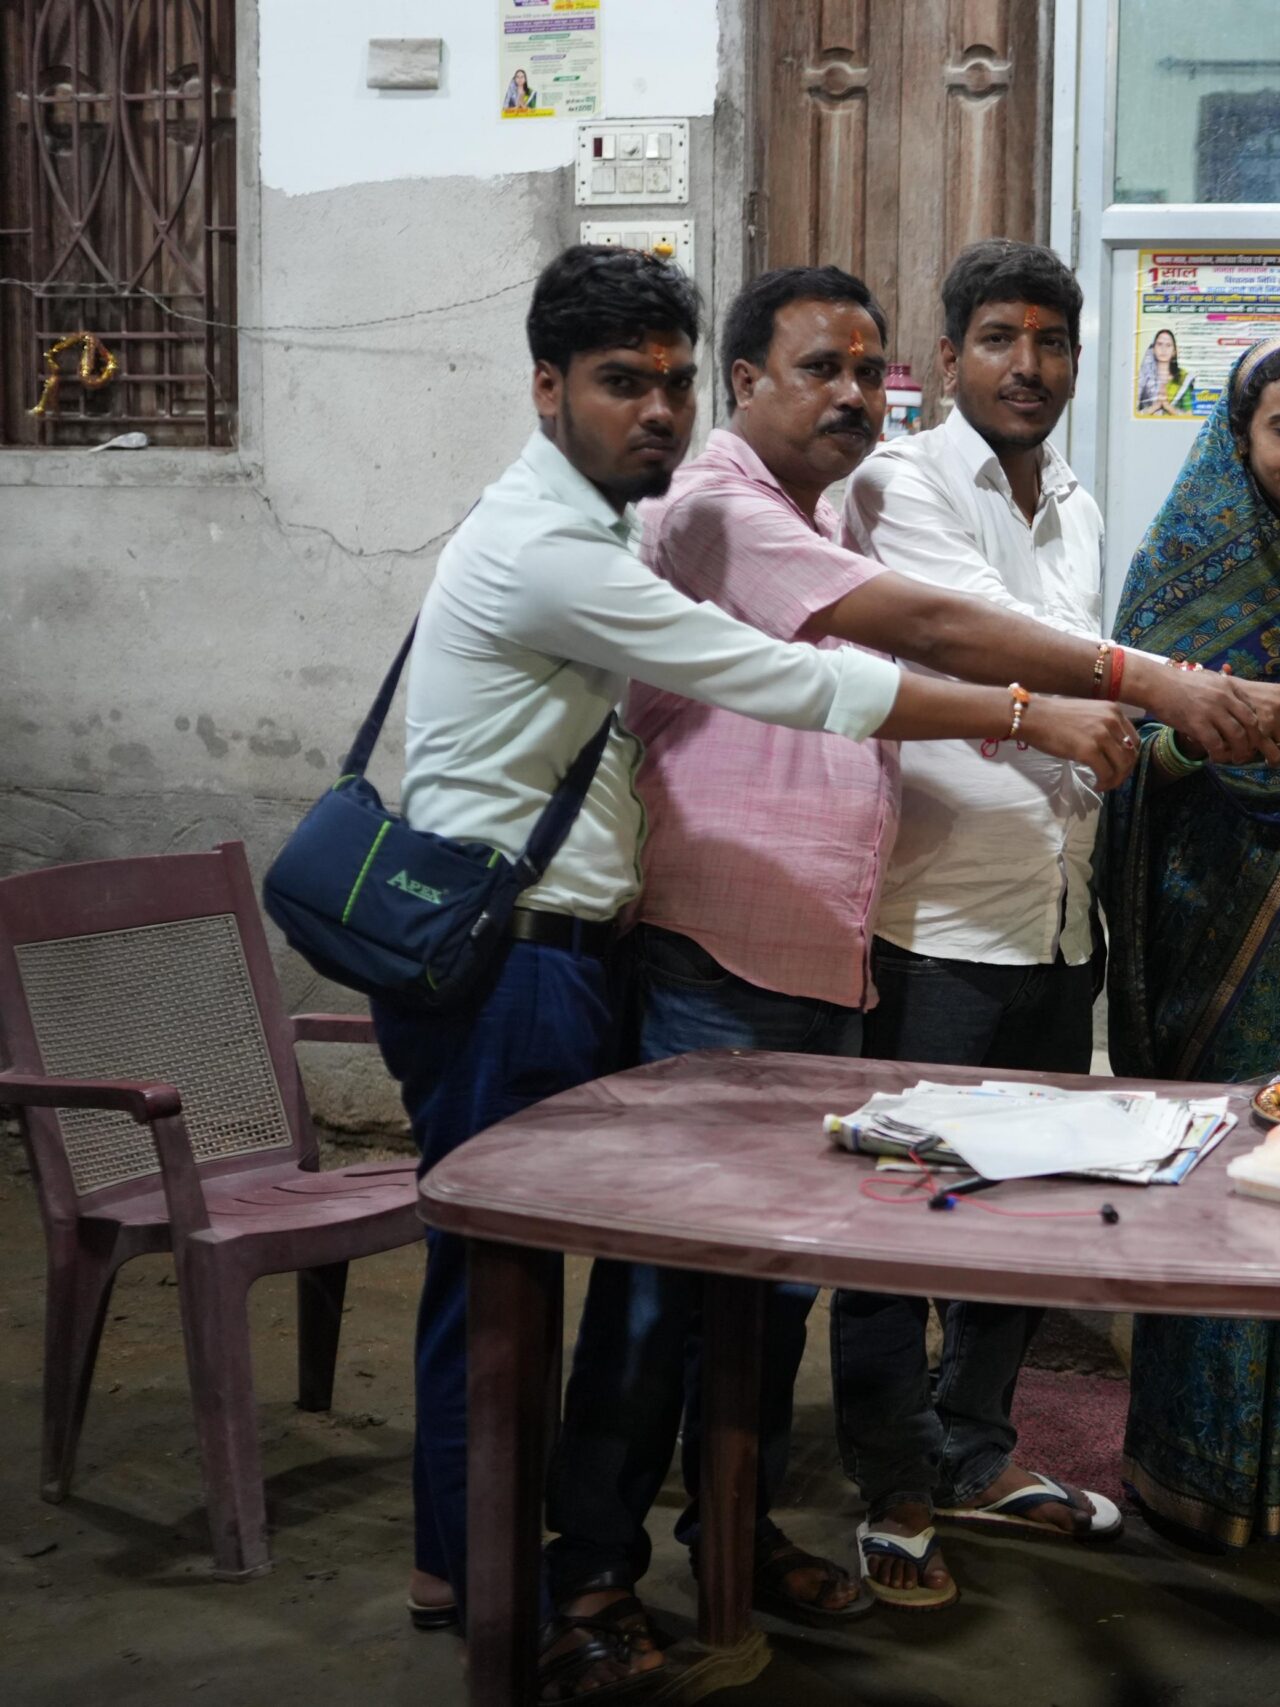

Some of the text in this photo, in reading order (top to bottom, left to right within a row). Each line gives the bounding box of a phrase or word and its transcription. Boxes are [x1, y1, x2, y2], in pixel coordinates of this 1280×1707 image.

[1148, 267, 1198, 286] 1 साल
[386, 870, 442, 904] APEX
